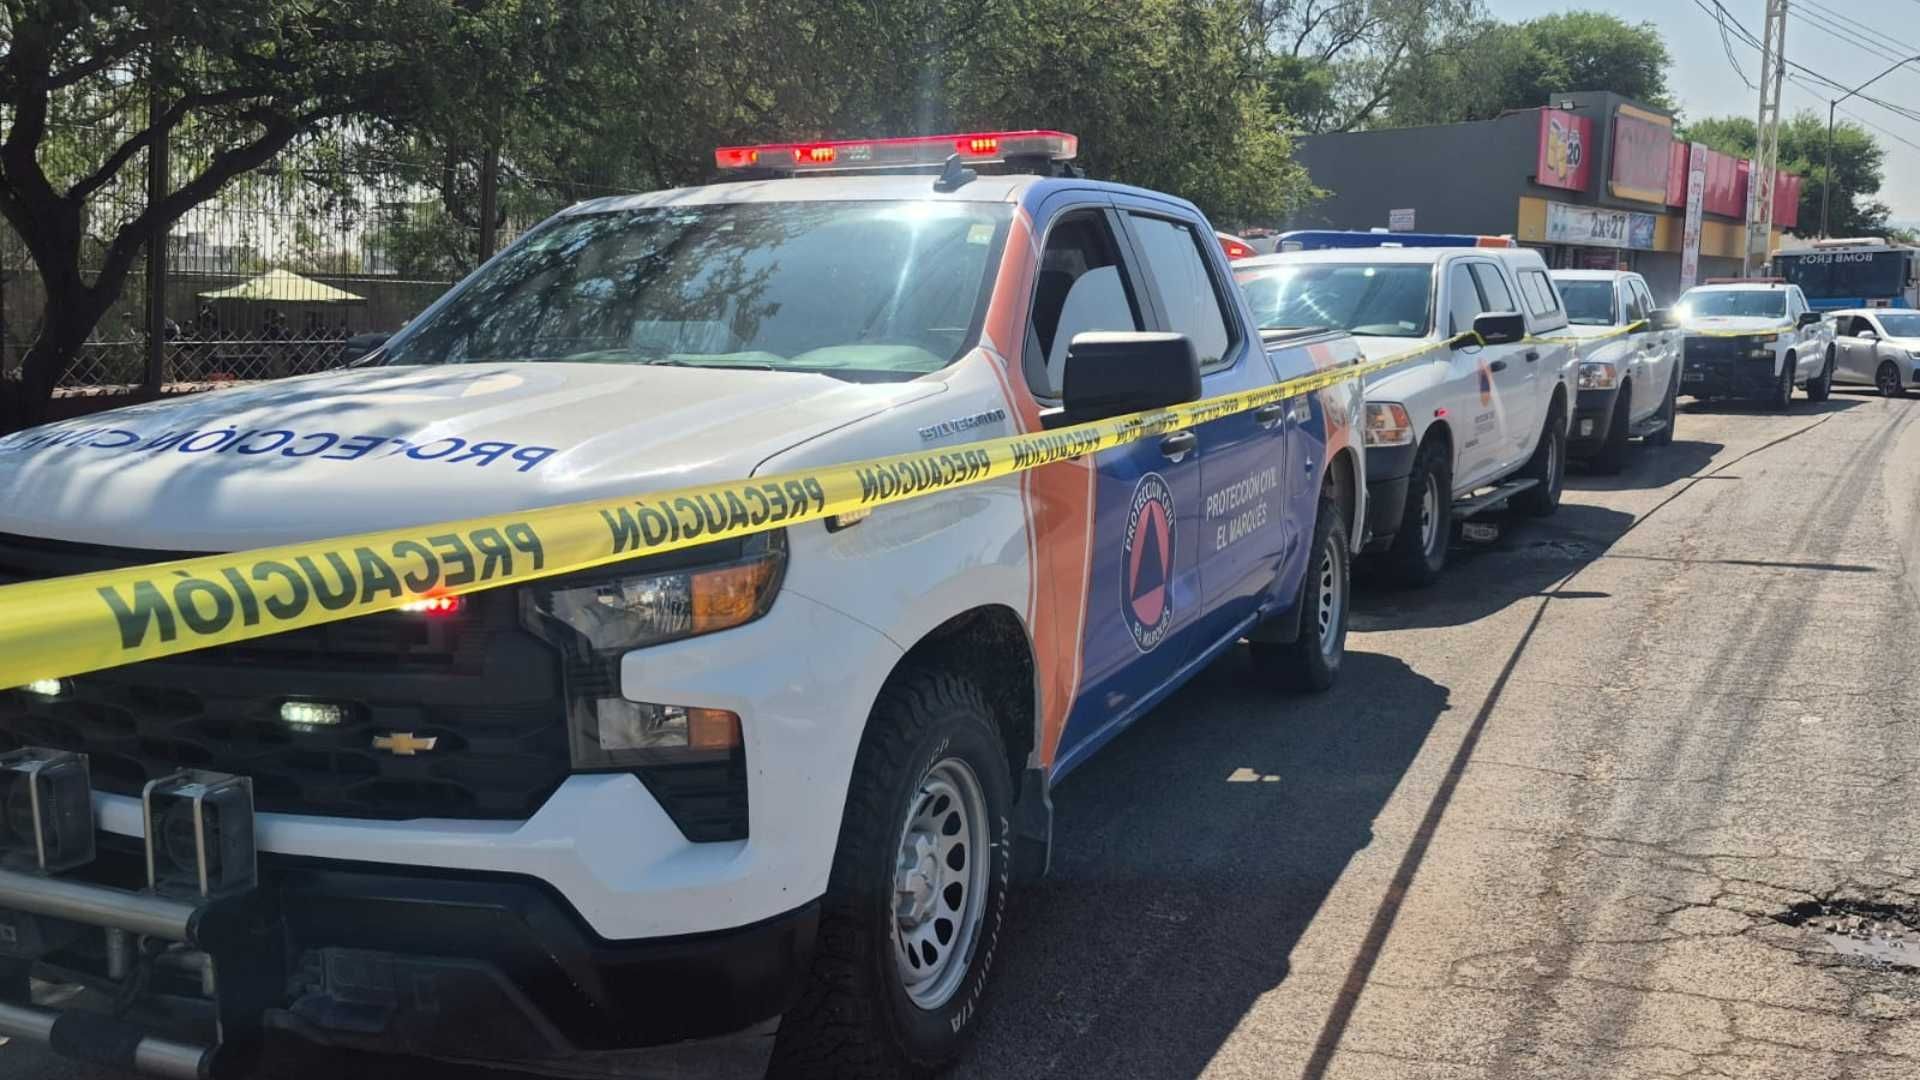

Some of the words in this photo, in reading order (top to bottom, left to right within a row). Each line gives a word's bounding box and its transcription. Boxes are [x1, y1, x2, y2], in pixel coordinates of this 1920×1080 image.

[1125, 477, 1163, 553] PROTECCIÓN
[1206, 471, 1260, 521] PROTECCIÓN
[1260, 466, 1278, 491] CIVIL
[1216, 526, 1229, 551] EL
[1229, 497, 1269, 545] MARQUÉS
